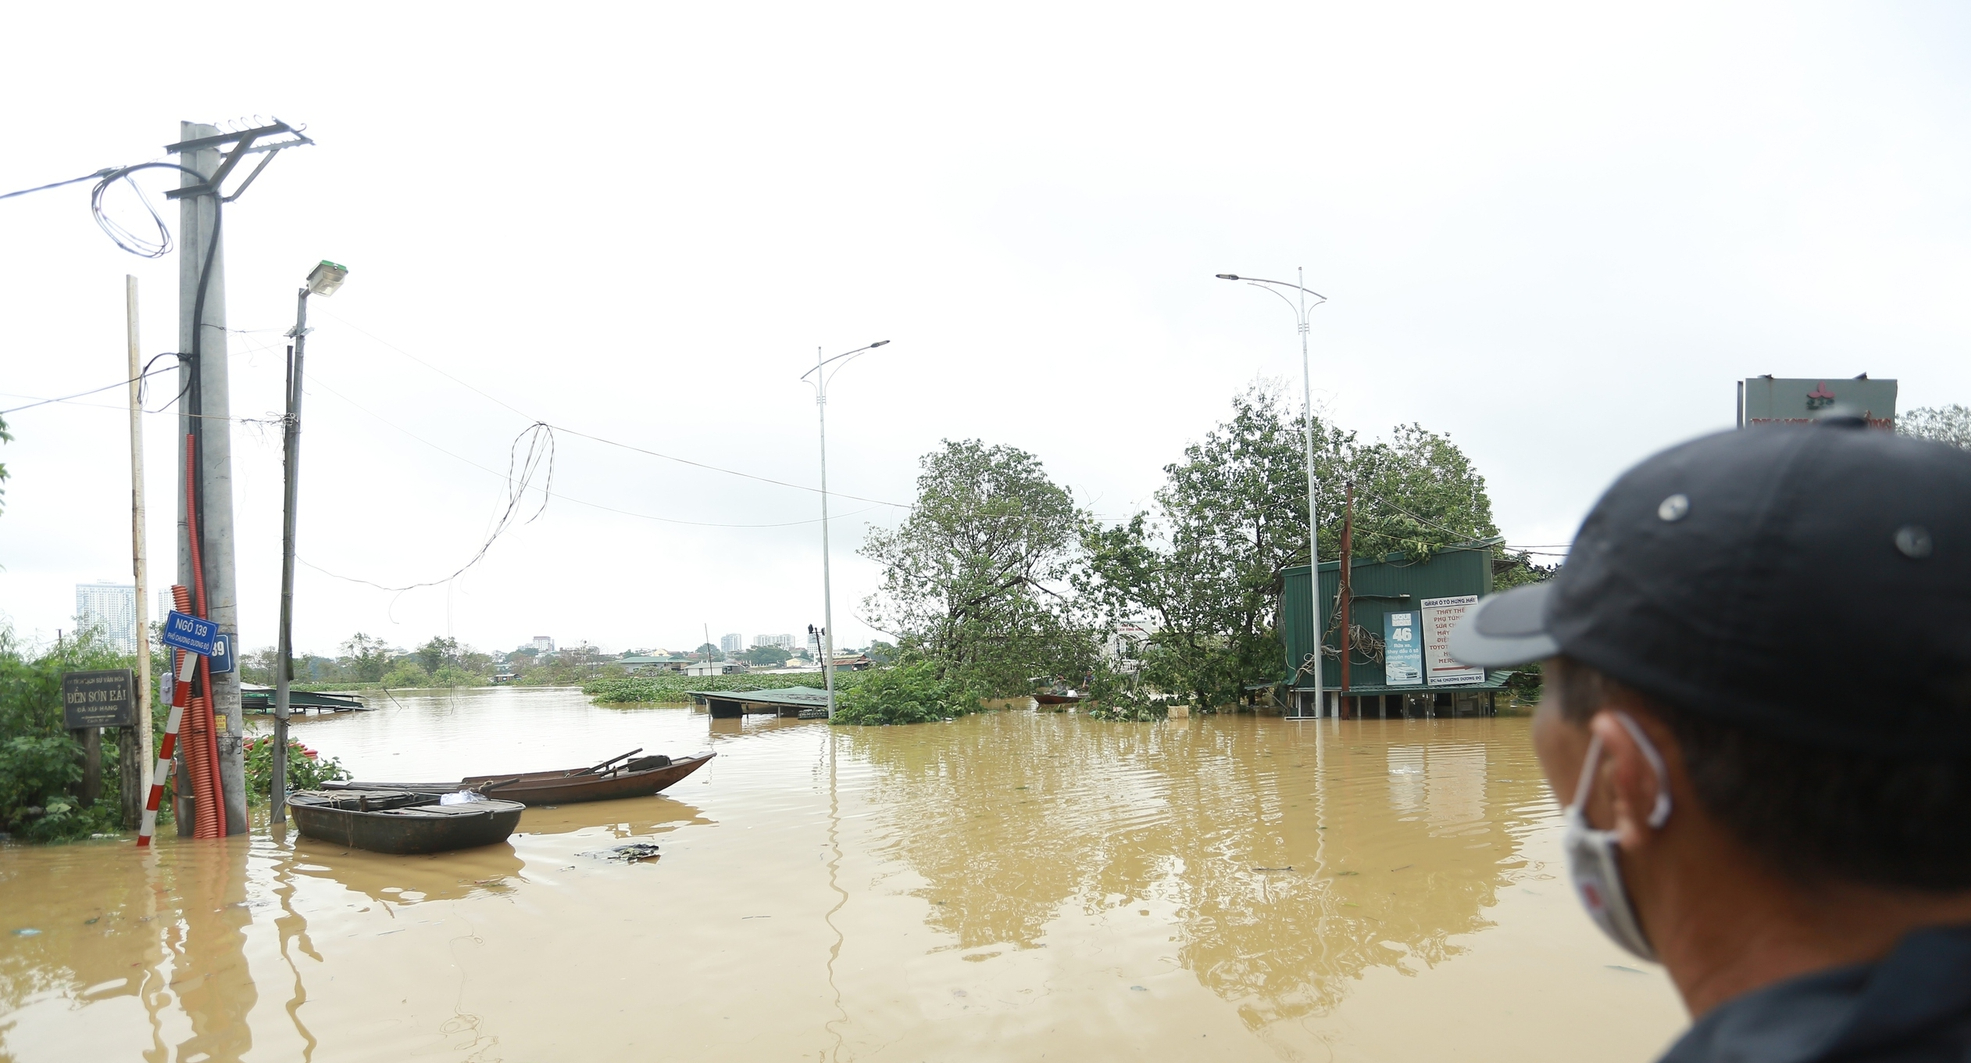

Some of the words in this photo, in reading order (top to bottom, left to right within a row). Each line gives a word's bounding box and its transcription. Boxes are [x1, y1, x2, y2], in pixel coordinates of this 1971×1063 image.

[175, 618, 194, 632] NGÕ
[194, 624, 208, 637] 139
[1392, 628, 1412, 642] 46
[167, 632, 176, 640] PHỐ
[174, 634, 190, 645] CHƯƠNG
[190, 639, 204, 648] DƯƠNG
[67, 686, 86, 704] ĐỀN
[88, 688, 107, 702] SƠN
